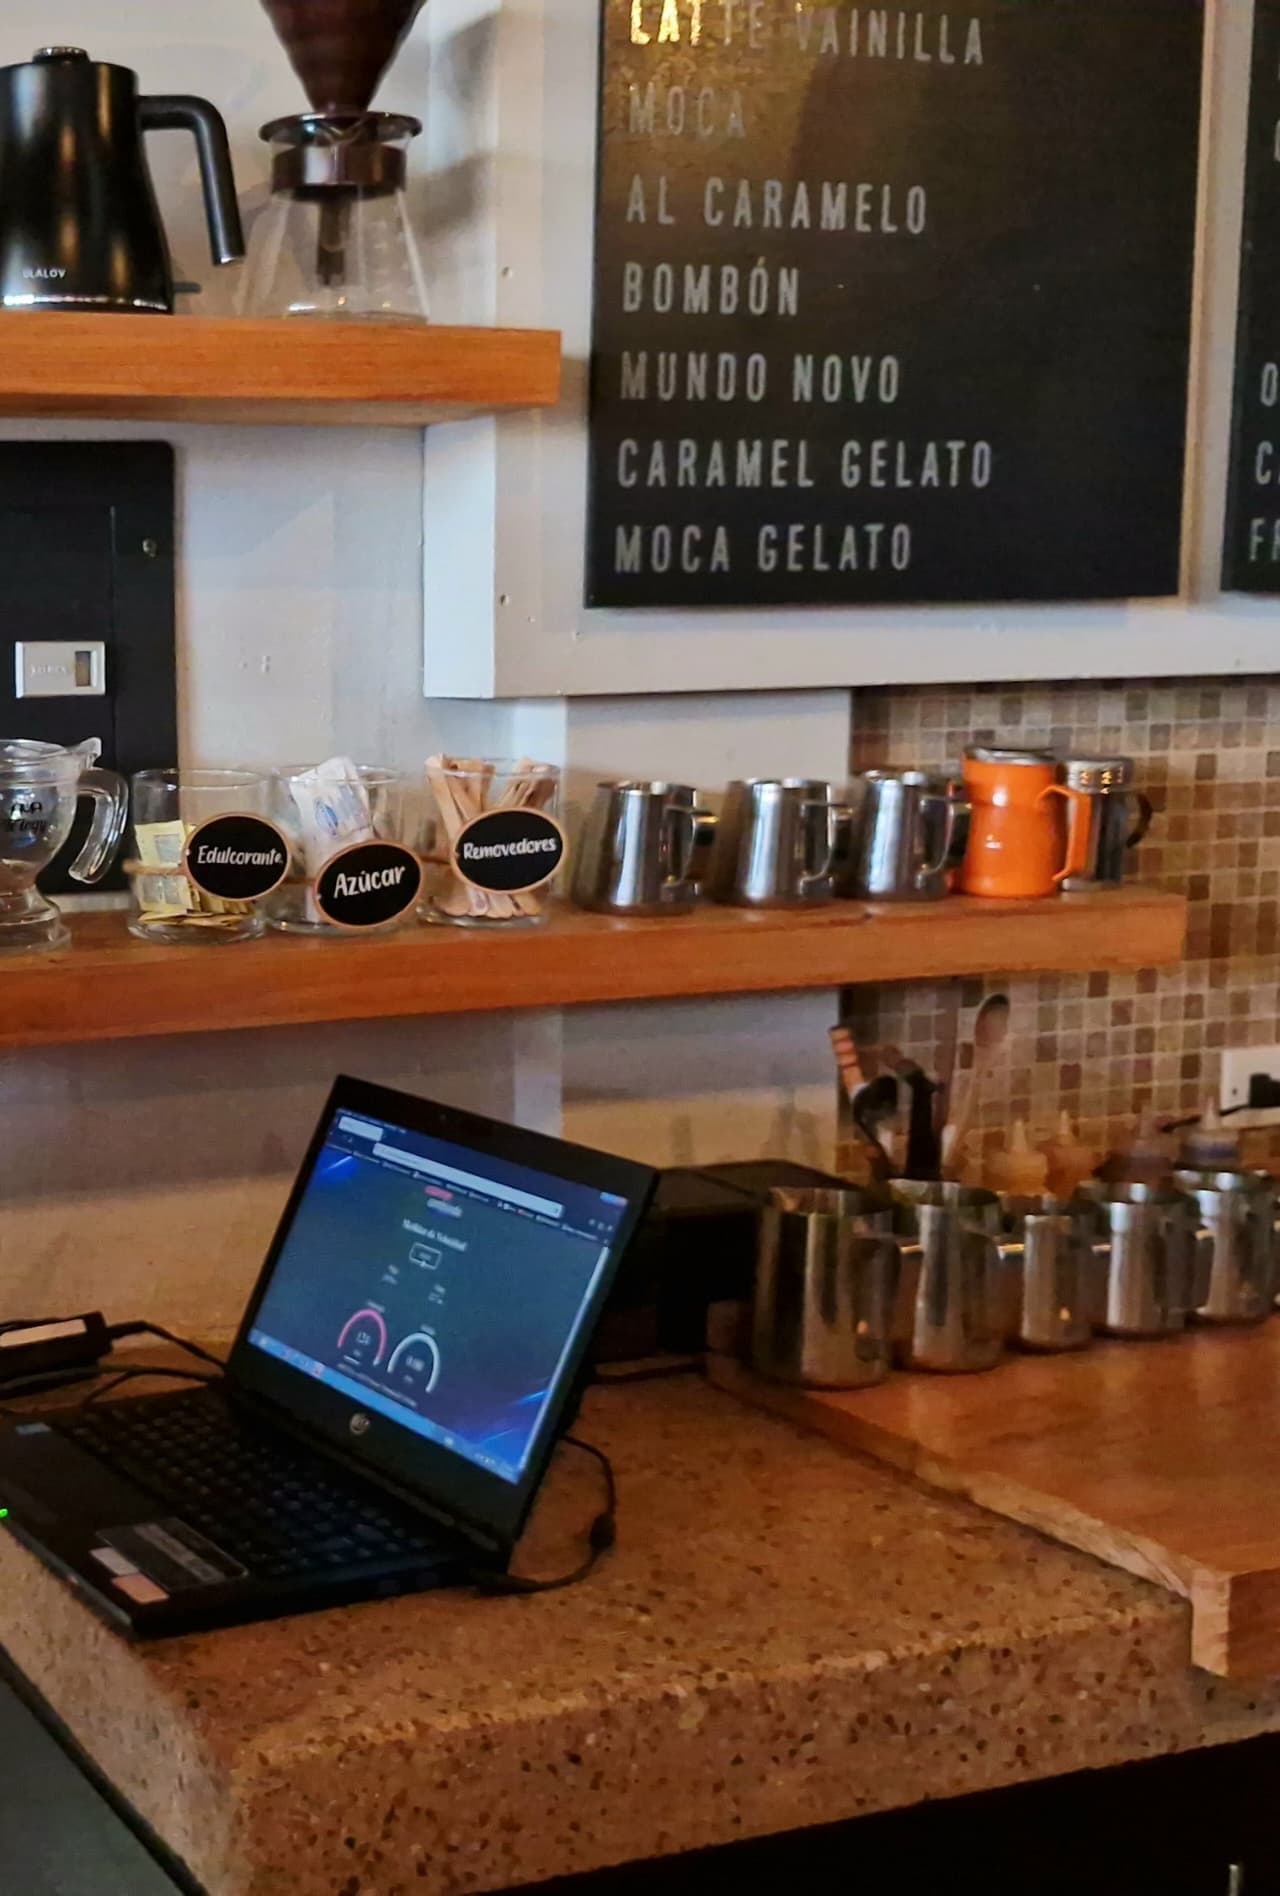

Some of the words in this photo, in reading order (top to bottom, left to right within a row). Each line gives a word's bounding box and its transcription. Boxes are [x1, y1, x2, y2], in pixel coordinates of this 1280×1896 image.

[629, 0, 769, 48] LATTE
[794, 3, 984, 66] VAINILLA
[629, 81, 746, 138] MOCA
[626, 173, 675, 225] AL
[704, 175, 927, 234] CARAMELO
[622, 256, 800, 316] BOMBÓN
[620, 351, 768, 402] MUNDO
[792, 354, 900, 404] NOVO
[616, 438, 815, 488] CARAMEL
[840, 439, 993, 489] GELATO
[614, 523, 732, 573] MOCA
[757, 523, 911, 573] GELATO
[197, 845, 283, 866] Edulcorante
[463, 838, 557, 860] Removedores
[333, 865, 406, 899] Azúcar
